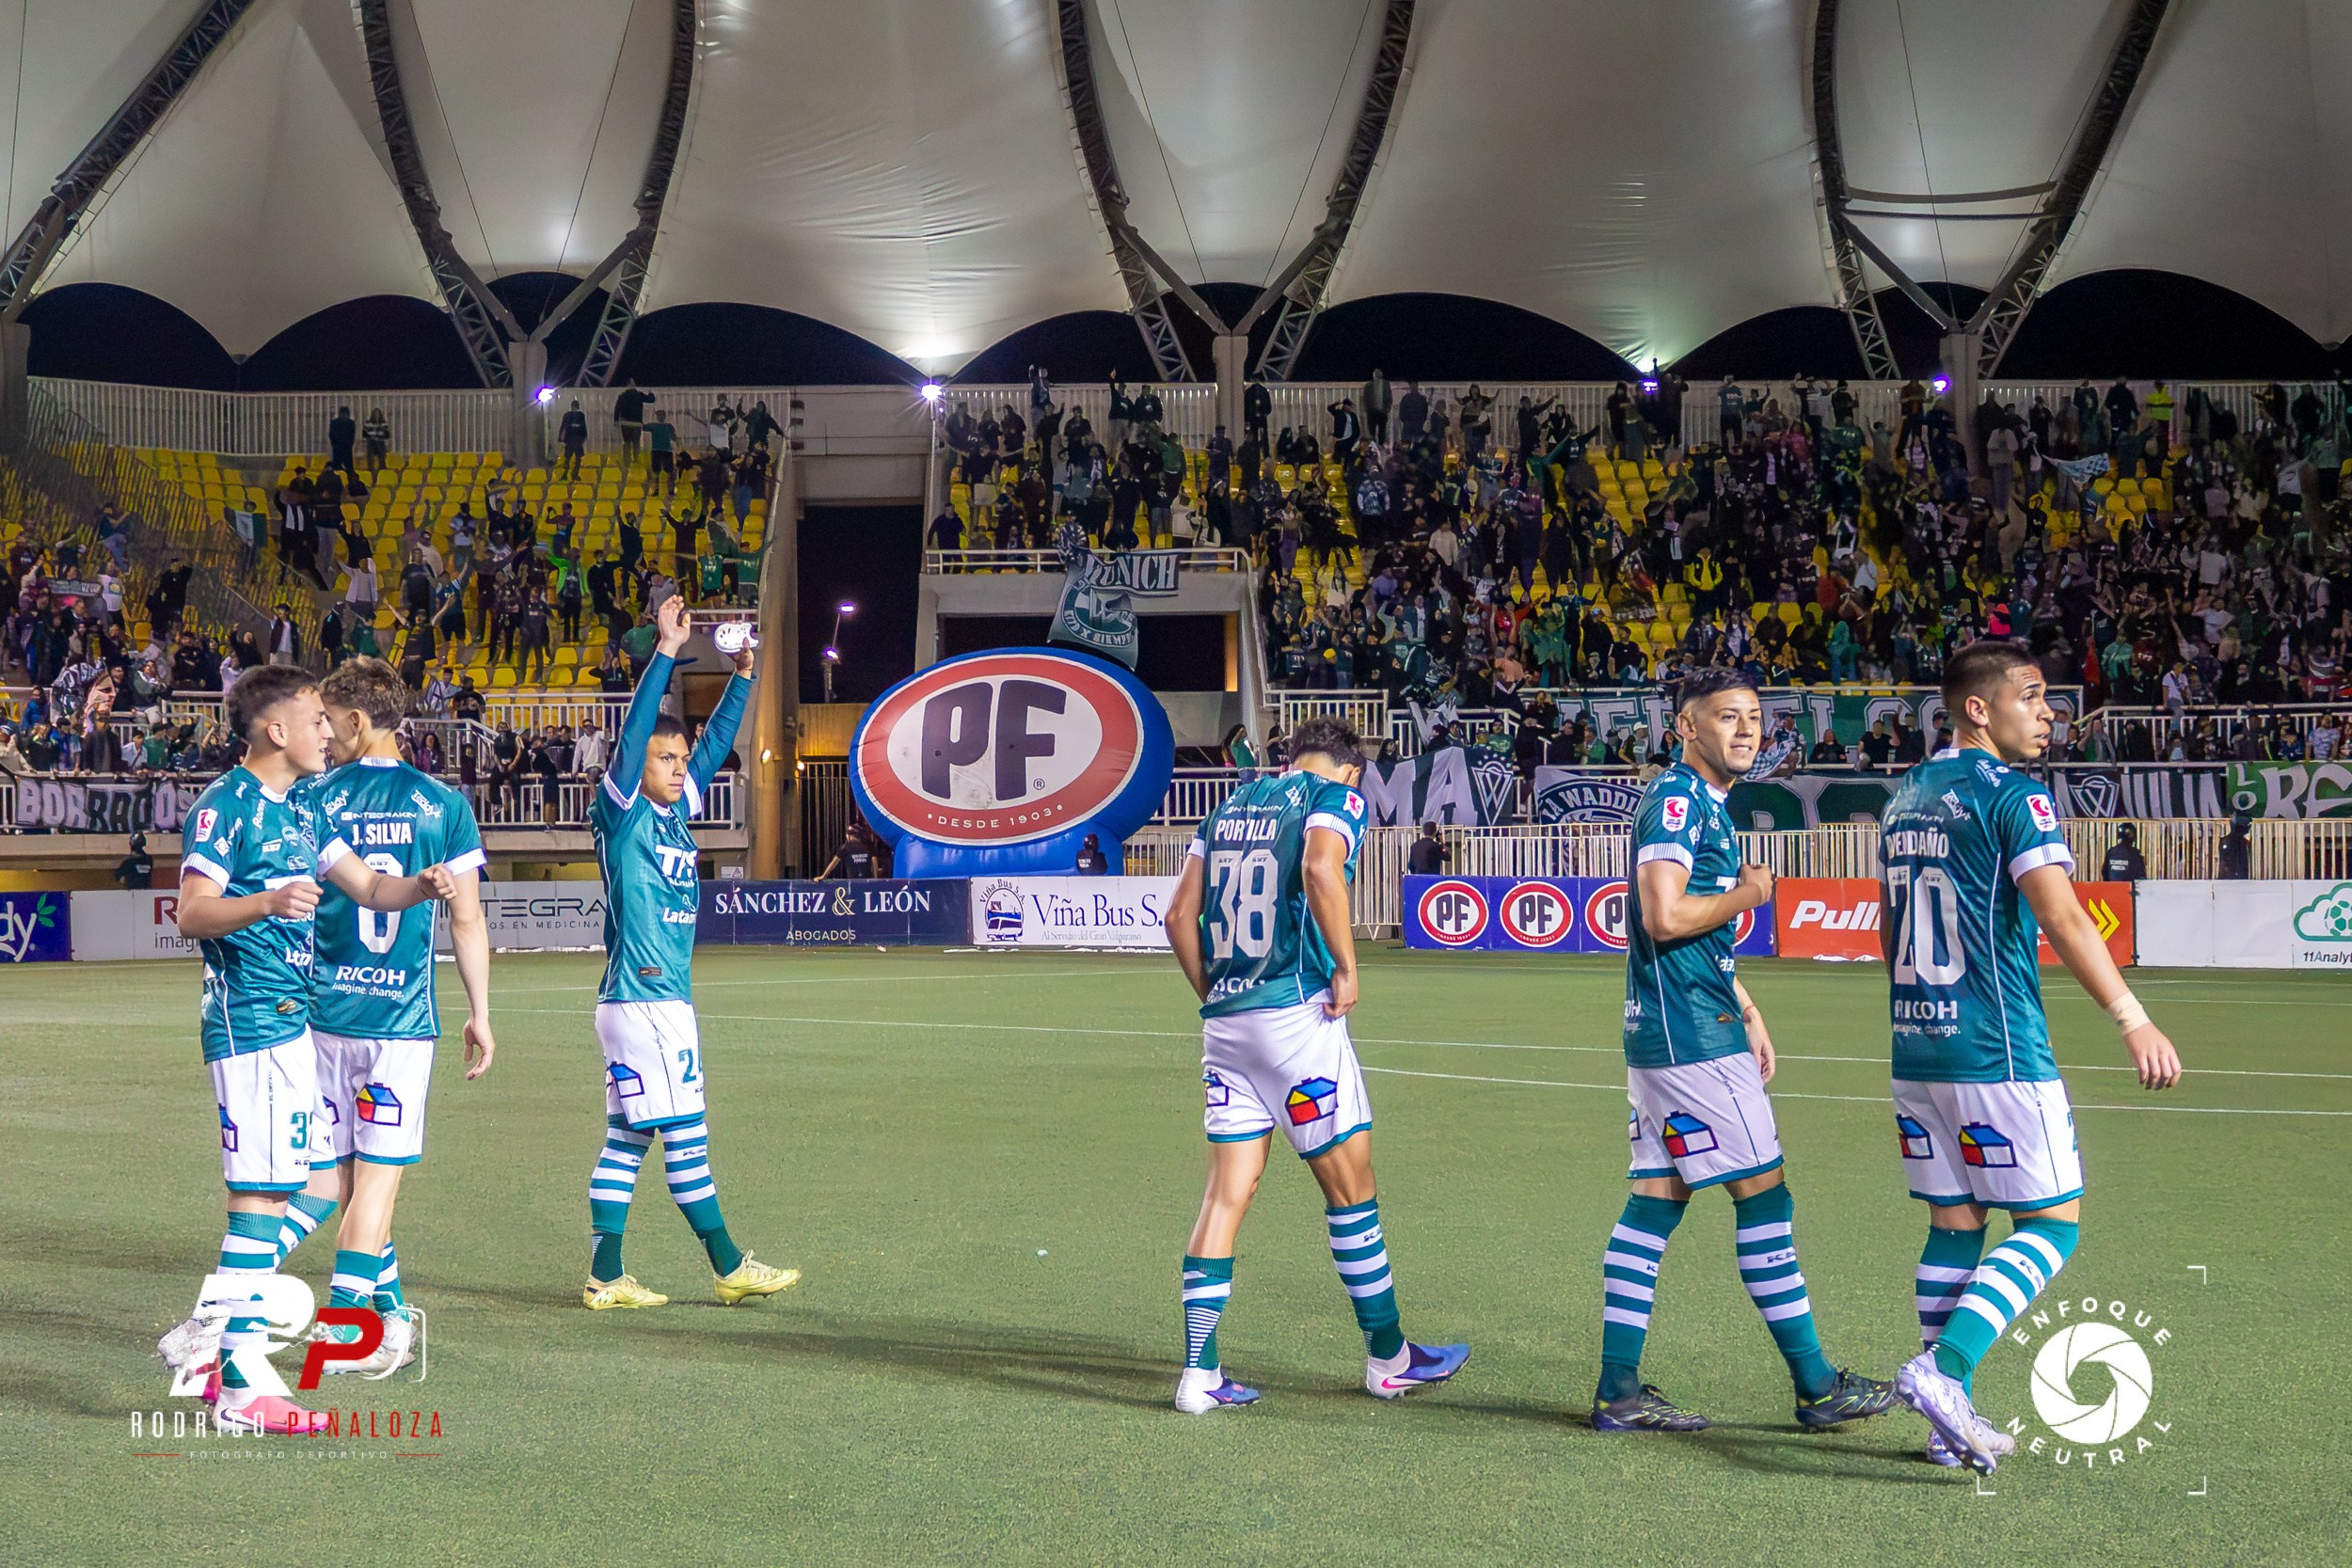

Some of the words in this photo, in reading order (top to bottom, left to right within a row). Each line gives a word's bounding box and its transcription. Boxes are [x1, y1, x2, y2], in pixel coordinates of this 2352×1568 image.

[922, 679, 1067, 800] PF
[938, 815, 1000, 829] DESDE
[1009, 807, 1053, 827] 1903
[352, 824, 363, 846] J.
[365, 823, 412, 845] SILVA
[715, 884, 826, 915] SÁNCHEZ
[832, 887, 856, 916] &
[864, 884, 930, 913] LEÓN
[1031, 894, 1085, 927] Viña
[1092, 894, 1135, 927] Bus
[1209, 848, 1279, 958] 38
[1436, 894, 1470, 932] PF
[1518, 895, 1554, 934] PF
[1605, 895, 1628, 932] P
[513, 920, 528, 929] EN
[536, 920, 600, 929] MEDICINA
[786, 928, 857, 941] ABOGADOS
[1886, 864, 1966, 985] 70
[335, 965, 406, 986] RICOH
[1894, 999, 1959, 1021] RICOH
